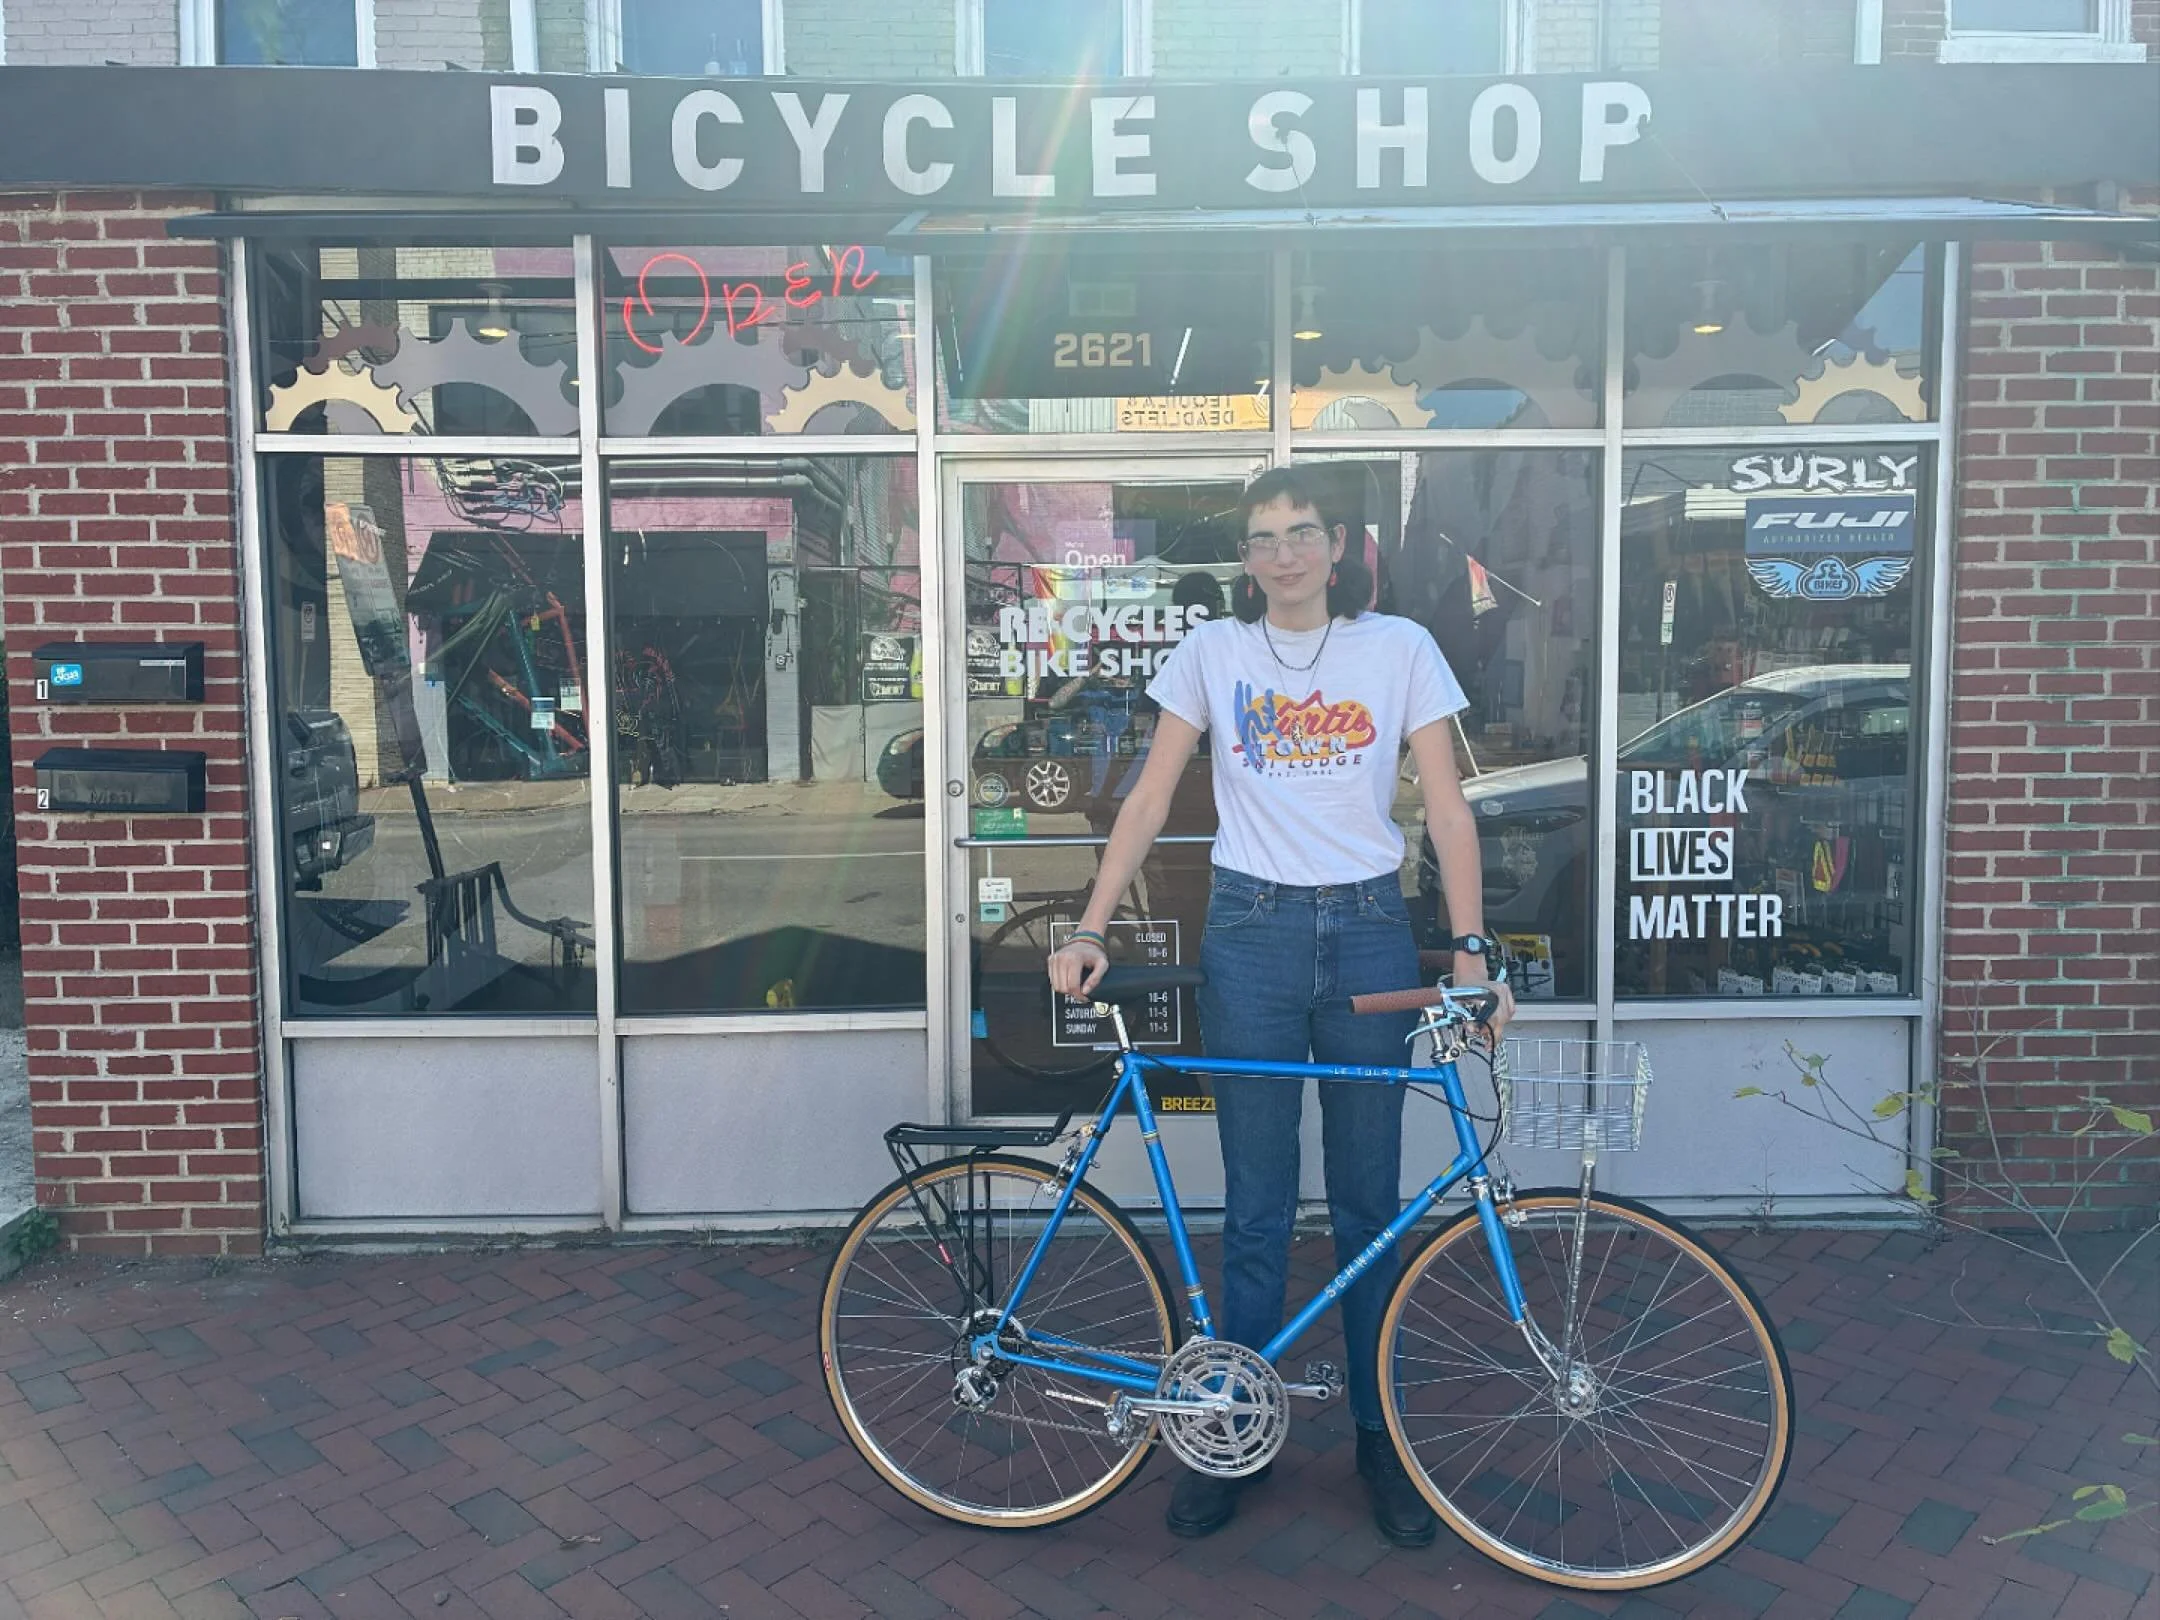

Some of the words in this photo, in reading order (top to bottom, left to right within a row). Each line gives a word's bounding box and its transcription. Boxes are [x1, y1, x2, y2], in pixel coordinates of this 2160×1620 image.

[490, 85, 1157, 197] BICYCLE
[1245, 82, 1652, 193] SHOP
[1054, 332, 1151, 378] 2621
[1731, 453, 1918, 491] SURLY
[1752, 511, 1909, 529] FUJI
[1064, 550, 1127, 574] Open
[1000, 648, 1090, 678] BIKE
[1288, 755, 1363, 769] LODGE
[1631, 769, 1750, 815] BLACK
[1638, 831, 1729, 876] LIVES
[1629, 894, 1783, 940] MATTER
[1135, 932, 1167, 943] CLOSED
[1065, 1023, 1097, 1034] SUNDAY
[1323, 1227, 1396, 1298] SCHWINN
